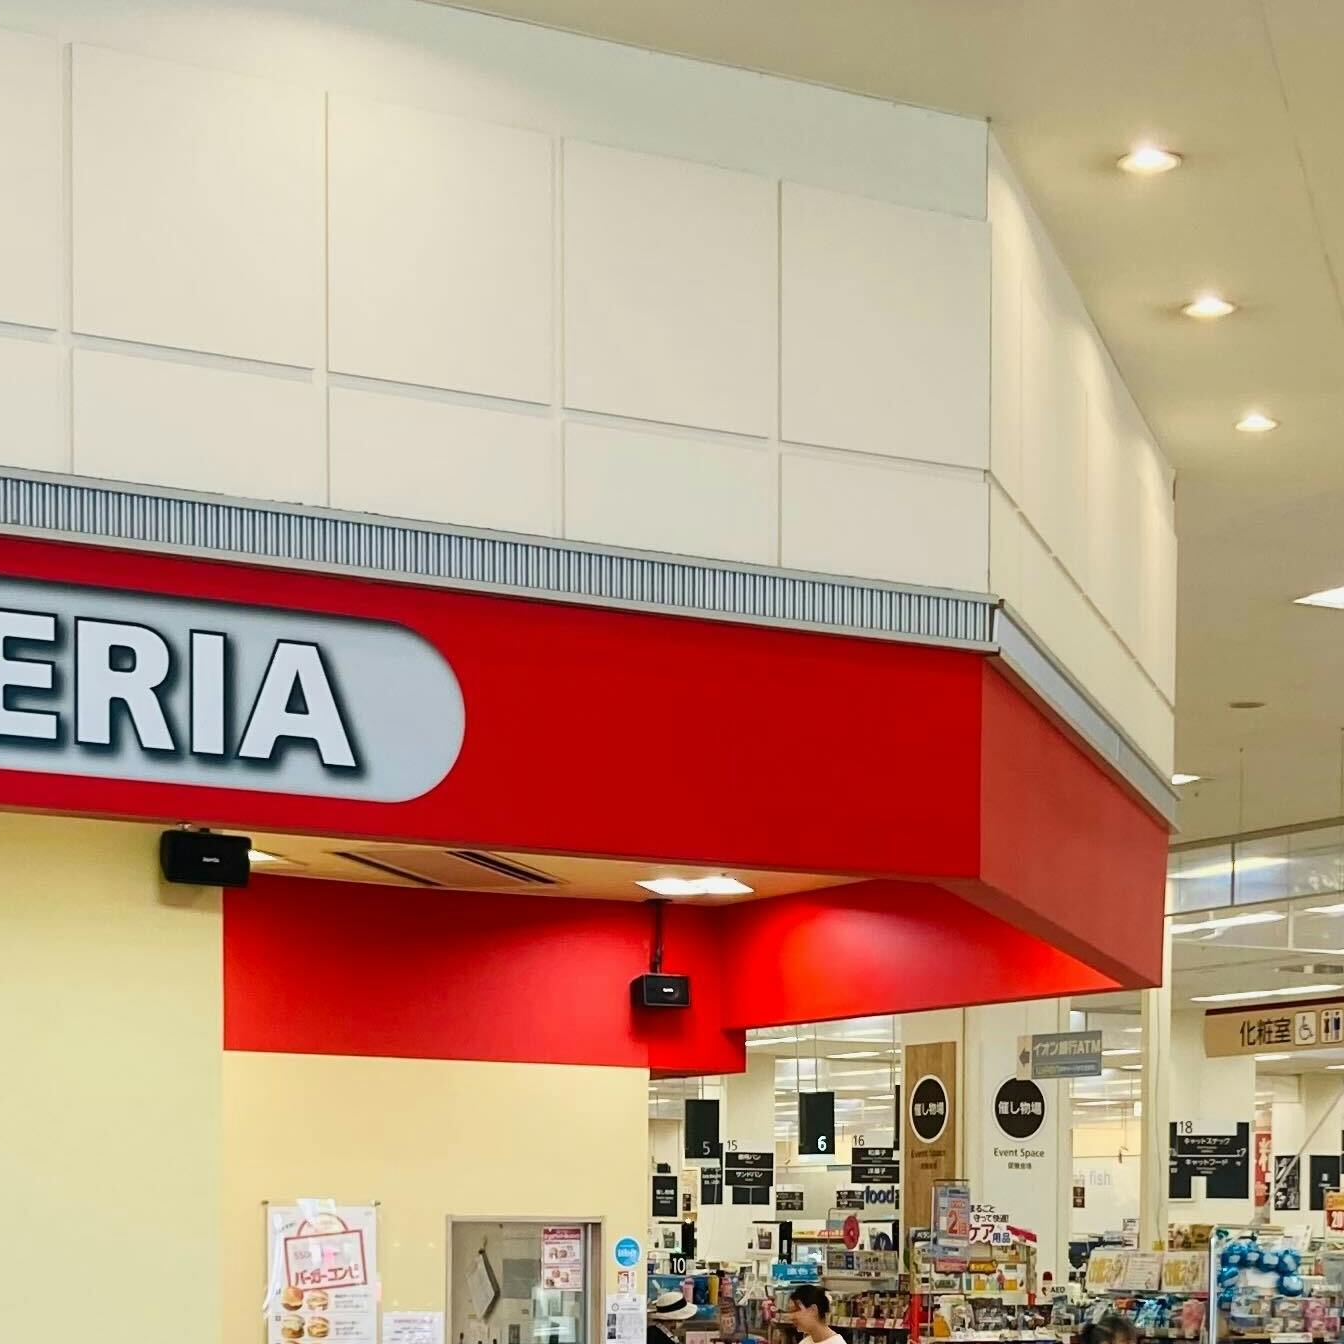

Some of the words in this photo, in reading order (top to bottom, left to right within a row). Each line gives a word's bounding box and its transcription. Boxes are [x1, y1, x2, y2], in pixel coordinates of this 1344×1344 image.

[1240, 1018, 1291, 1046] 化粧室
[998, 1101, 1041, 1115] 催し物場
[1180, 1121, 1193, 1134] 18
[727, 1140, 737, 1151] 15
[818, 1136, 827, 1151] 6
[854, 1135, 864, 1146] 16
[702, 1141, 710, 1155] 5
[994, 1148, 1017, 1157] Event
[1020, 1149, 1044, 1158] Space
[673, 1257, 685, 1273] 10
